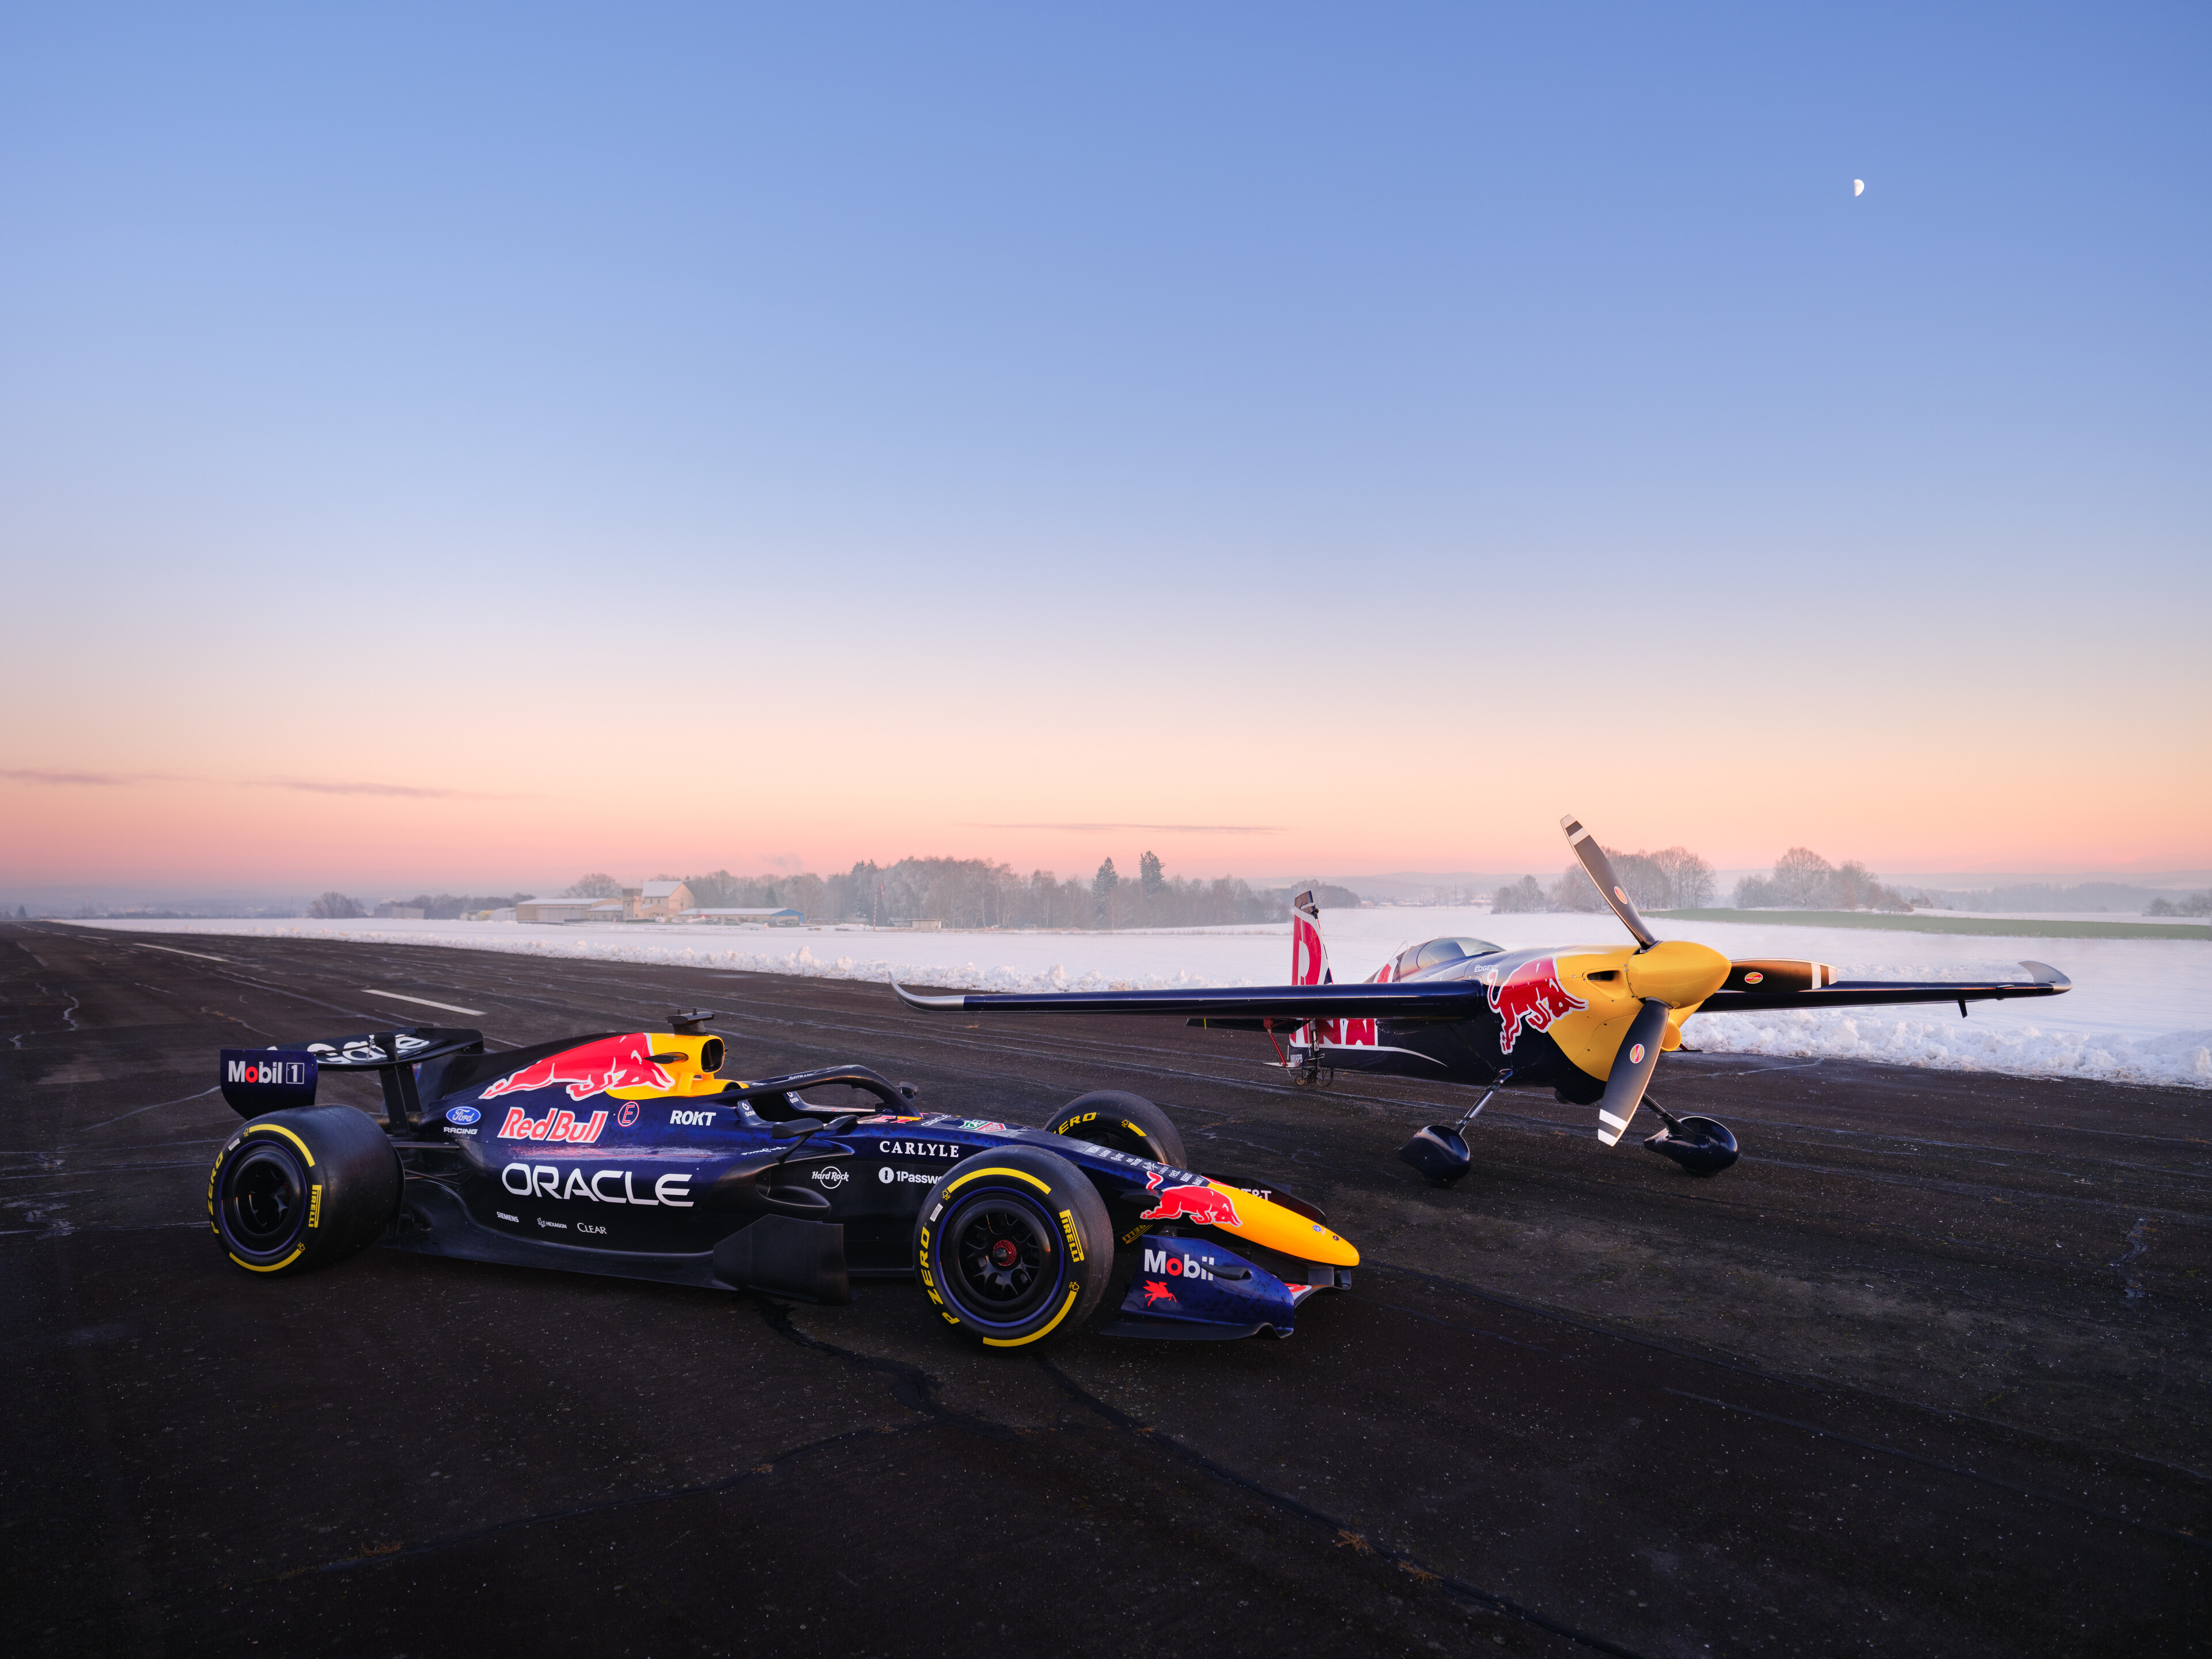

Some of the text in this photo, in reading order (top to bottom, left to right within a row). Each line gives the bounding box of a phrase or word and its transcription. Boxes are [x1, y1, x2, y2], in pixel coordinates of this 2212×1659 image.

[307, 1034, 430, 1064] Gae
[228, 1060, 282, 1084] Mobil
[452, 1107, 474, 1122] Ford
[670, 1110, 716, 1126] ROKT
[1053, 1112, 1097, 1135] ERO
[443, 1126, 478, 1135] RACING
[879, 1141, 959, 1158] CARLYLE
[502, 1162, 695, 1207] ORACLE
[812, 1171, 850, 1182] Hard Rock
[207, 1151, 224, 1234] P ZERO
[1241, 1188, 1271, 1202] T&T
[308, 1184, 322, 1228] PIRELLI
[497, 1211, 519, 1223] SIEMENS
[546, 1221, 567, 1229] HEXAGON
[577, 1222, 608, 1234] CLEAR
[1059, 1209, 1085, 1263] PIRELLI
[1122, 1224, 1153, 1244] RELLI
[1144, 1248, 1215, 1281] Mobil
[919, 1226, 960, 1324] P ZERO
